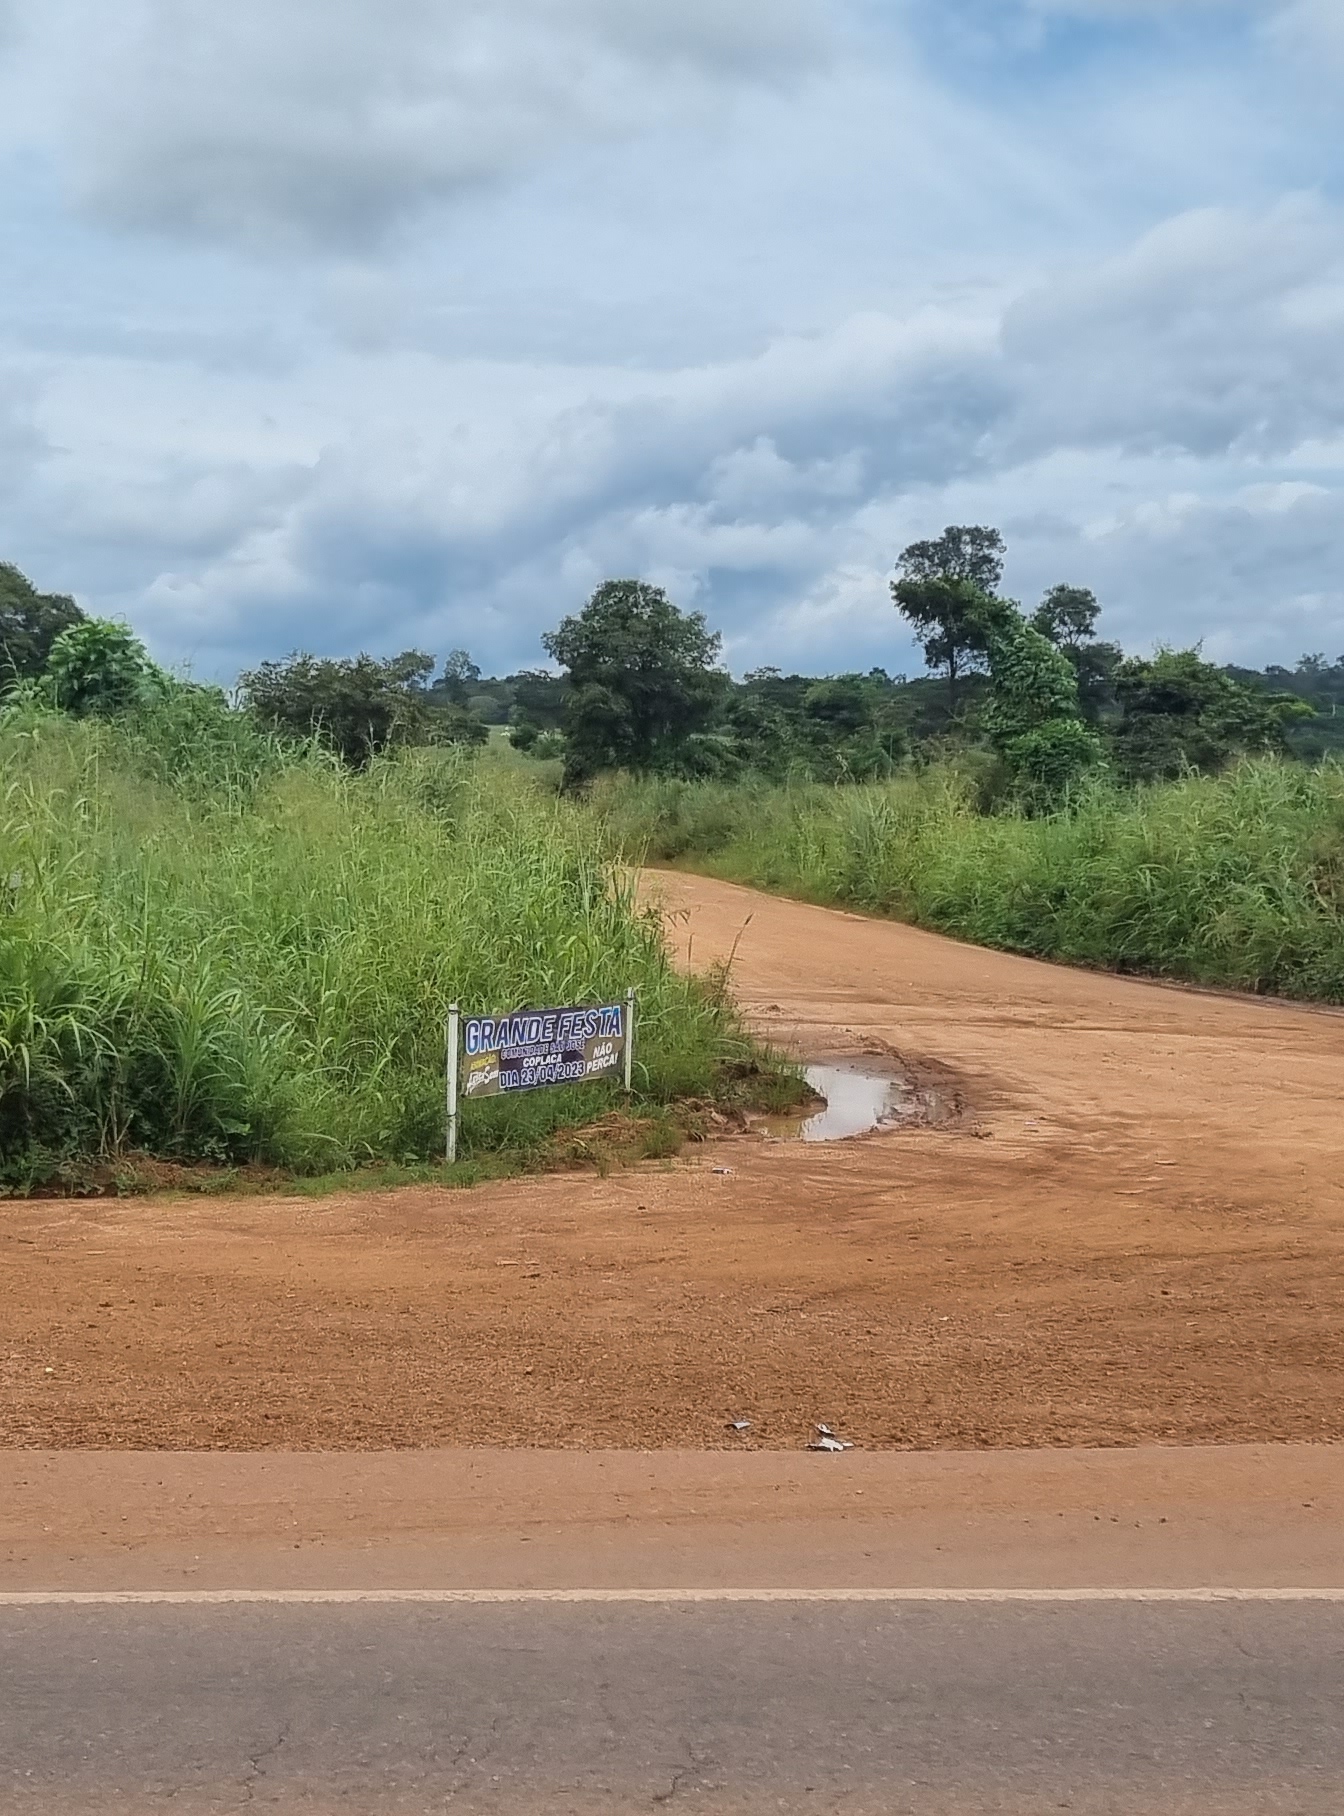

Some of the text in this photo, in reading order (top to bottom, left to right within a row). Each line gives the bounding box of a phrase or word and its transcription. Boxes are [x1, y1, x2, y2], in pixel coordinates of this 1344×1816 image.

[465, 1005, 623, 1055] GRANDE FESTA
[500, 1043, 549, 1060] COMUNIDADE
[592, 1042, 613, 1059] NÃO
[522, 1053, 563, 1068] COPLACA
[586, 1052, 619, 1074] PERCA!
[498, 1069, 520, 1089] DIA
[520, 1060, 587, 1086] 23/04/2023
